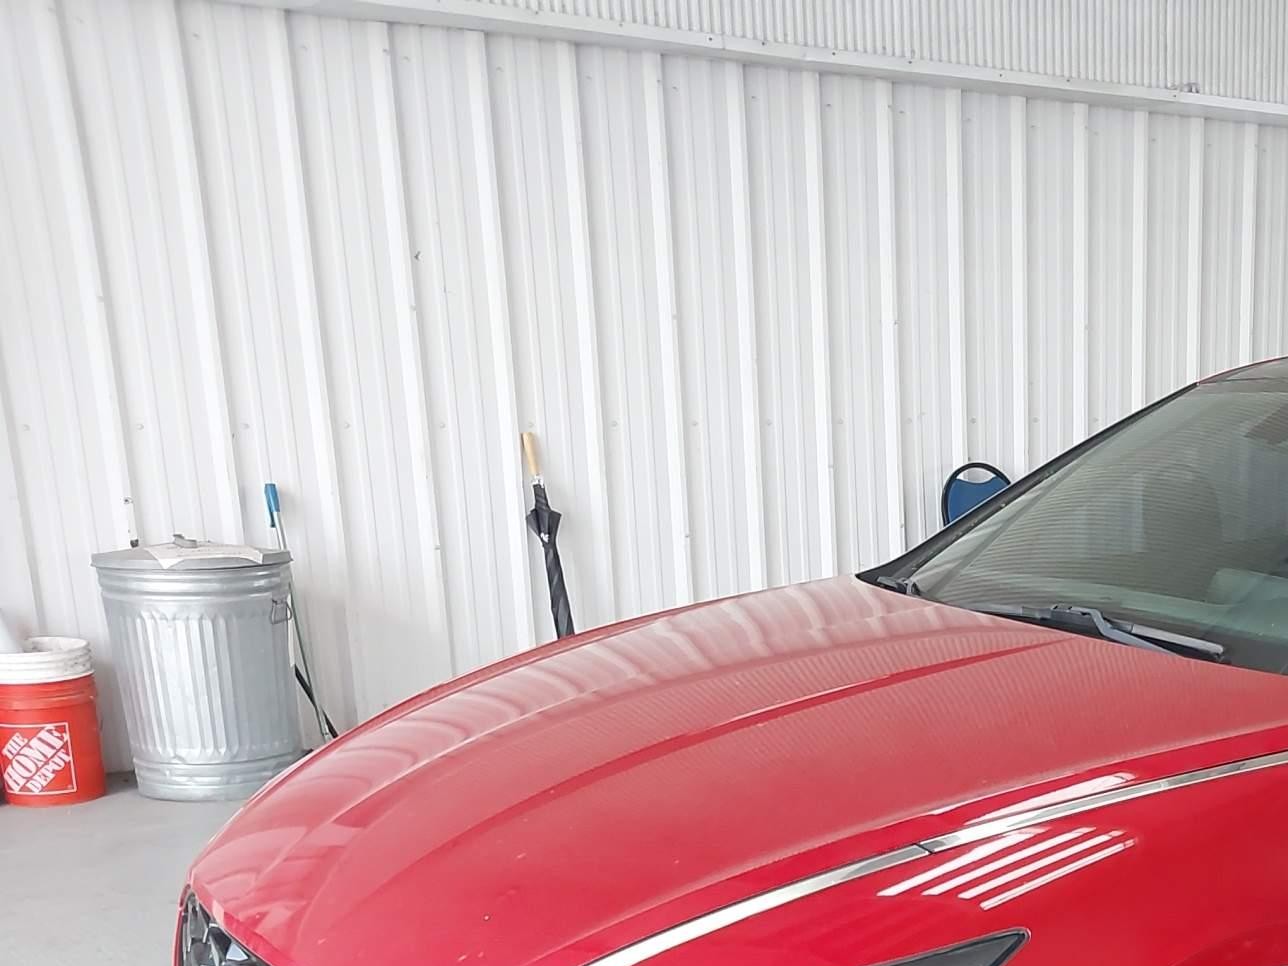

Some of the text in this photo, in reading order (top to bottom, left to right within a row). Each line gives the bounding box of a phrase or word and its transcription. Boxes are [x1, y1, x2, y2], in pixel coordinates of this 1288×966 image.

[1, 732, 29, 760] THE
[4, 726, 68, 792] HOME
[25, 749, 71, 793] DEPOT
